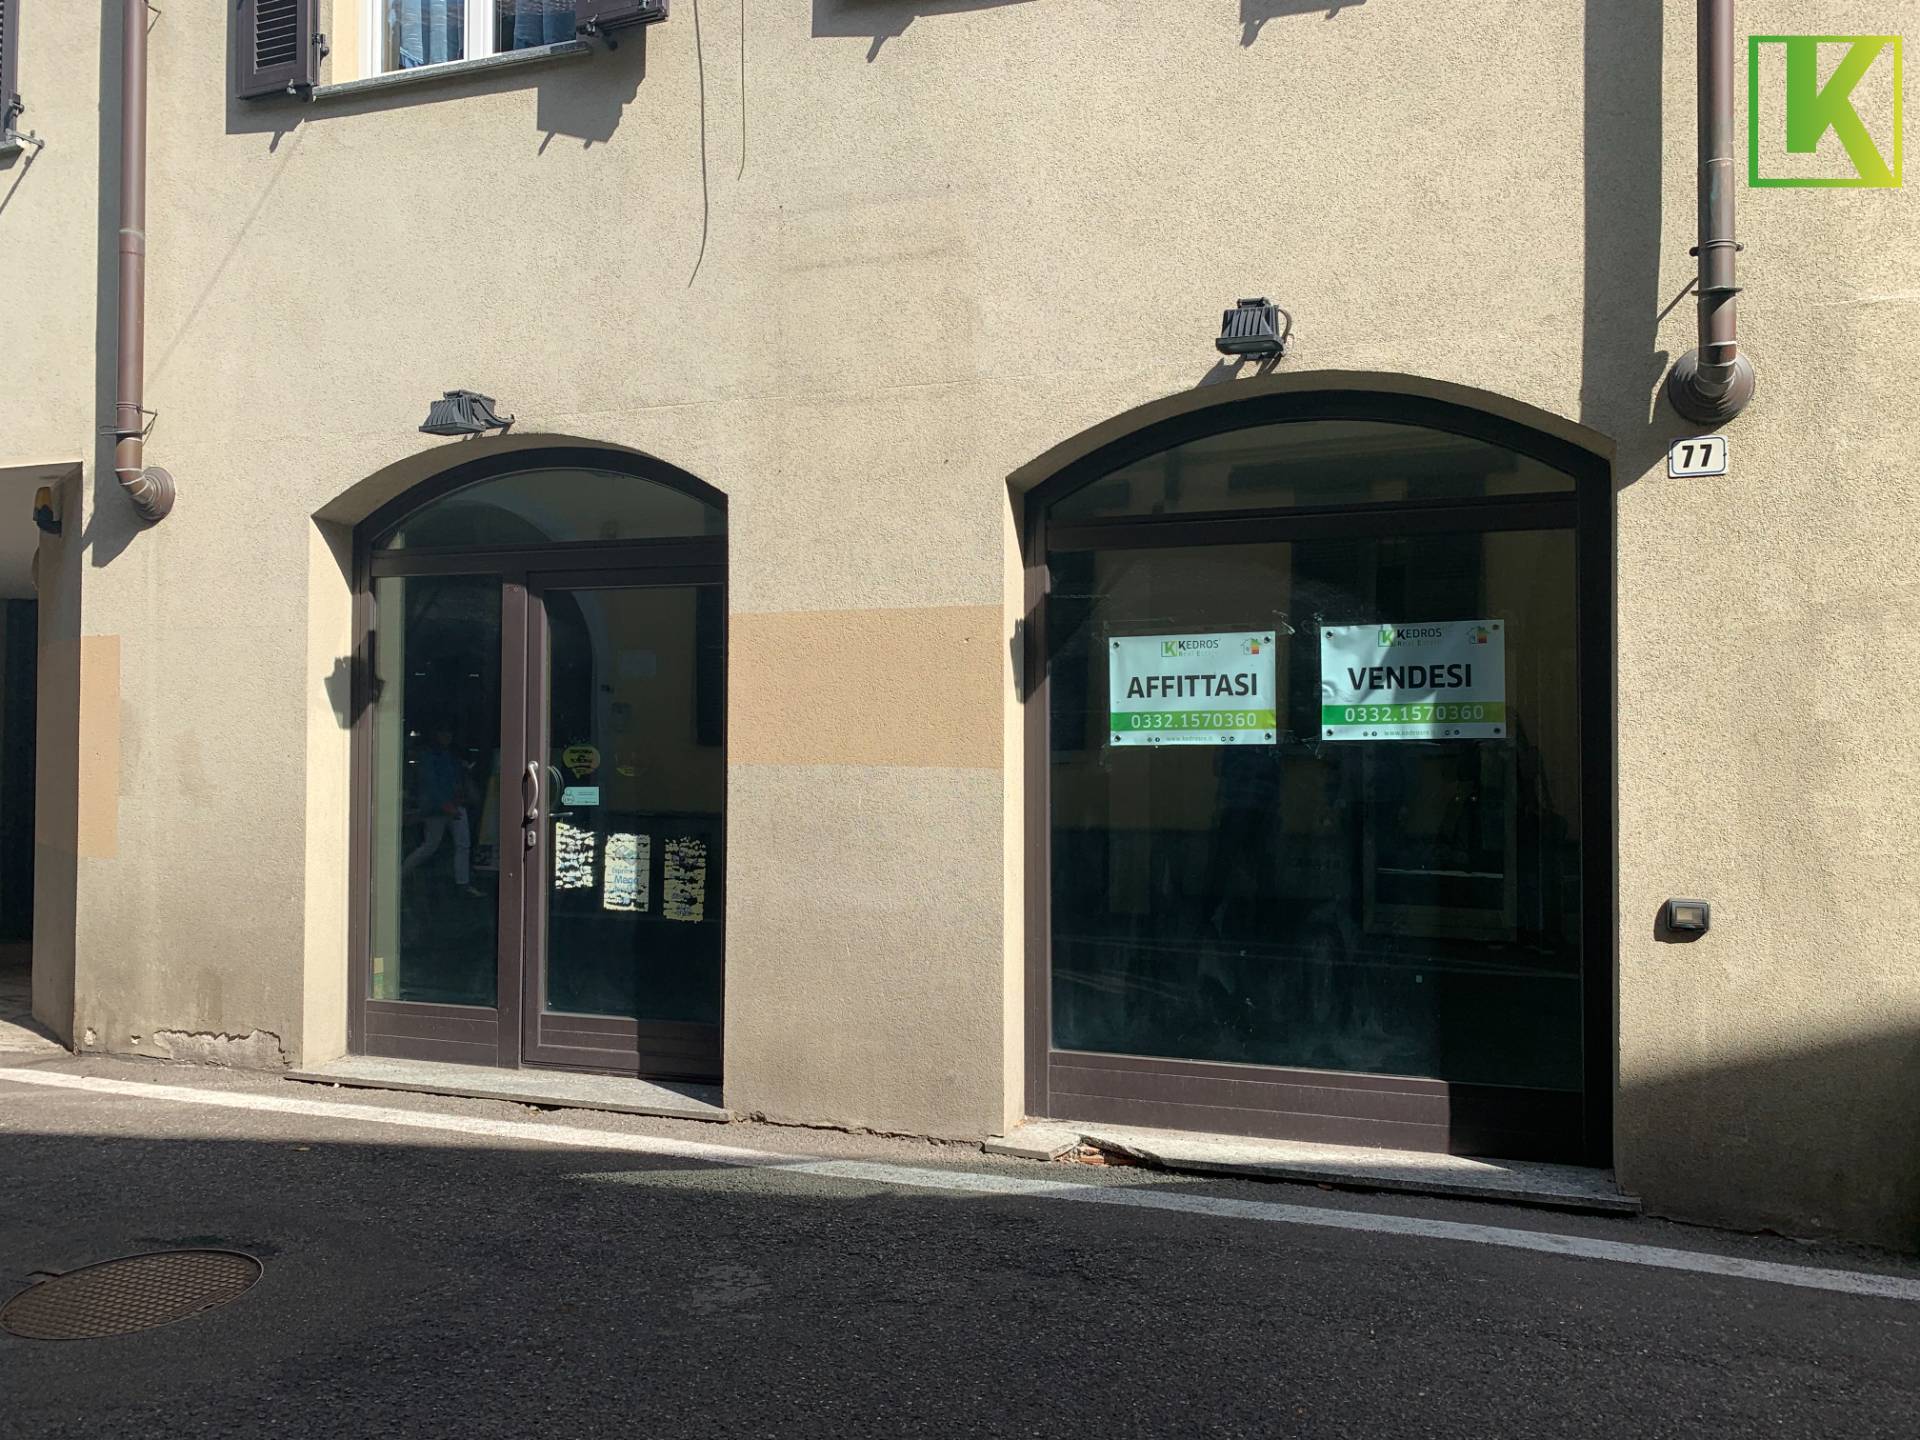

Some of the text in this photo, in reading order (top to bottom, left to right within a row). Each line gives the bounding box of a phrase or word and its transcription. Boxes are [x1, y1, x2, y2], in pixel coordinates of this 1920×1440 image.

[1681, 443, 1713, 469] 77
[1396, 628, 1442, 640] KEDROS
[1178, 639, 1219, 651] KEDROS
[1126, 673, 1258, 699] AFFITTASI
[1347, 663, 1472, 691] VENDESI
[1131, 712, 1257, 729] 0332.1570360
[1344, 705, 1485, 723] 0332.1570360
